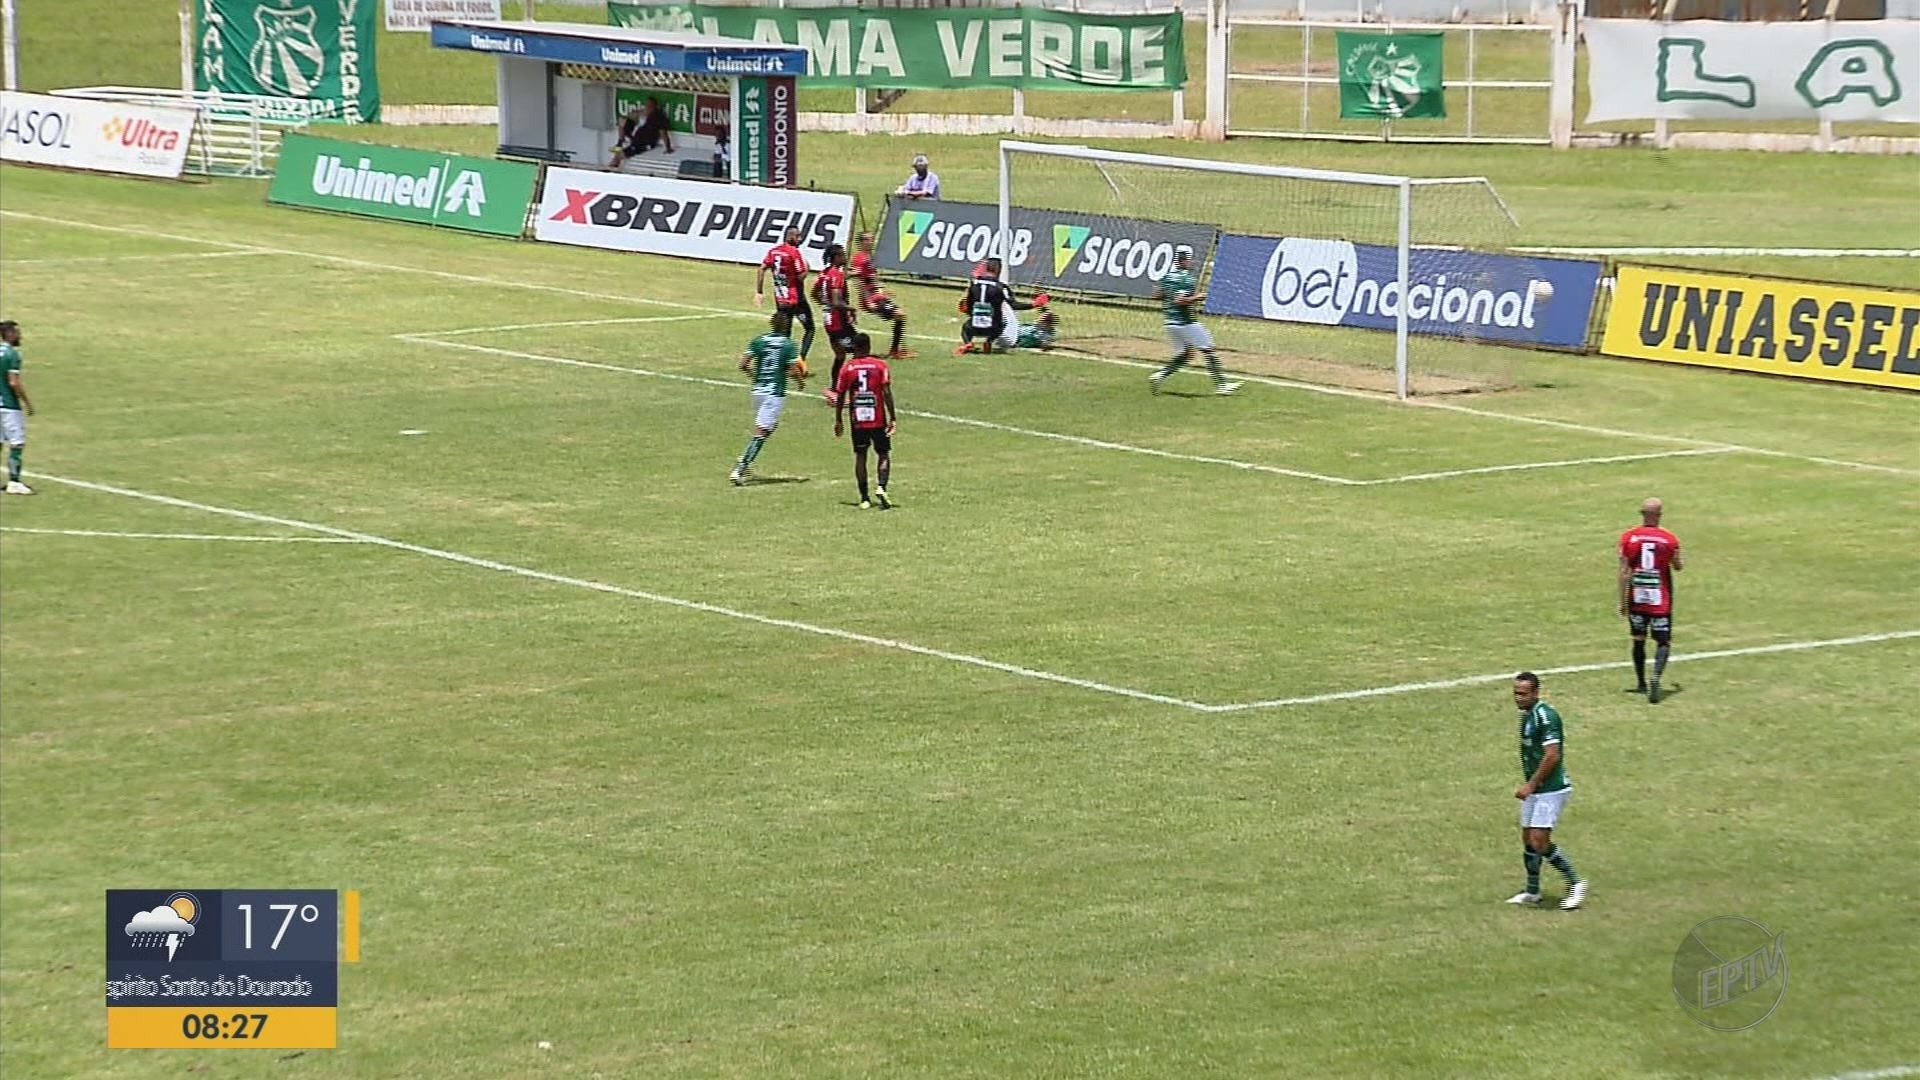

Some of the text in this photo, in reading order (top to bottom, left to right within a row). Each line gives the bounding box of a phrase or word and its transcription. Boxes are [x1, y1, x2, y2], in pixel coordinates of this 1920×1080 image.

[470, 34, 511, 53] Unimed
[601, 46, 641, 66] Unimed
[936, 18, 1166, 84] VERDE
[706, 56, 763, 74] Unimed
[120, 117, 181, 152] Ultra
[774, 84, 788, 186] UNIODONTO
[312, 154, 439, 210] Unimed
[549, 188, 844, 250] XBRI PNEUS
[857, 369, 868, 392] 5
[1640, 542, 1656, 570] 6
